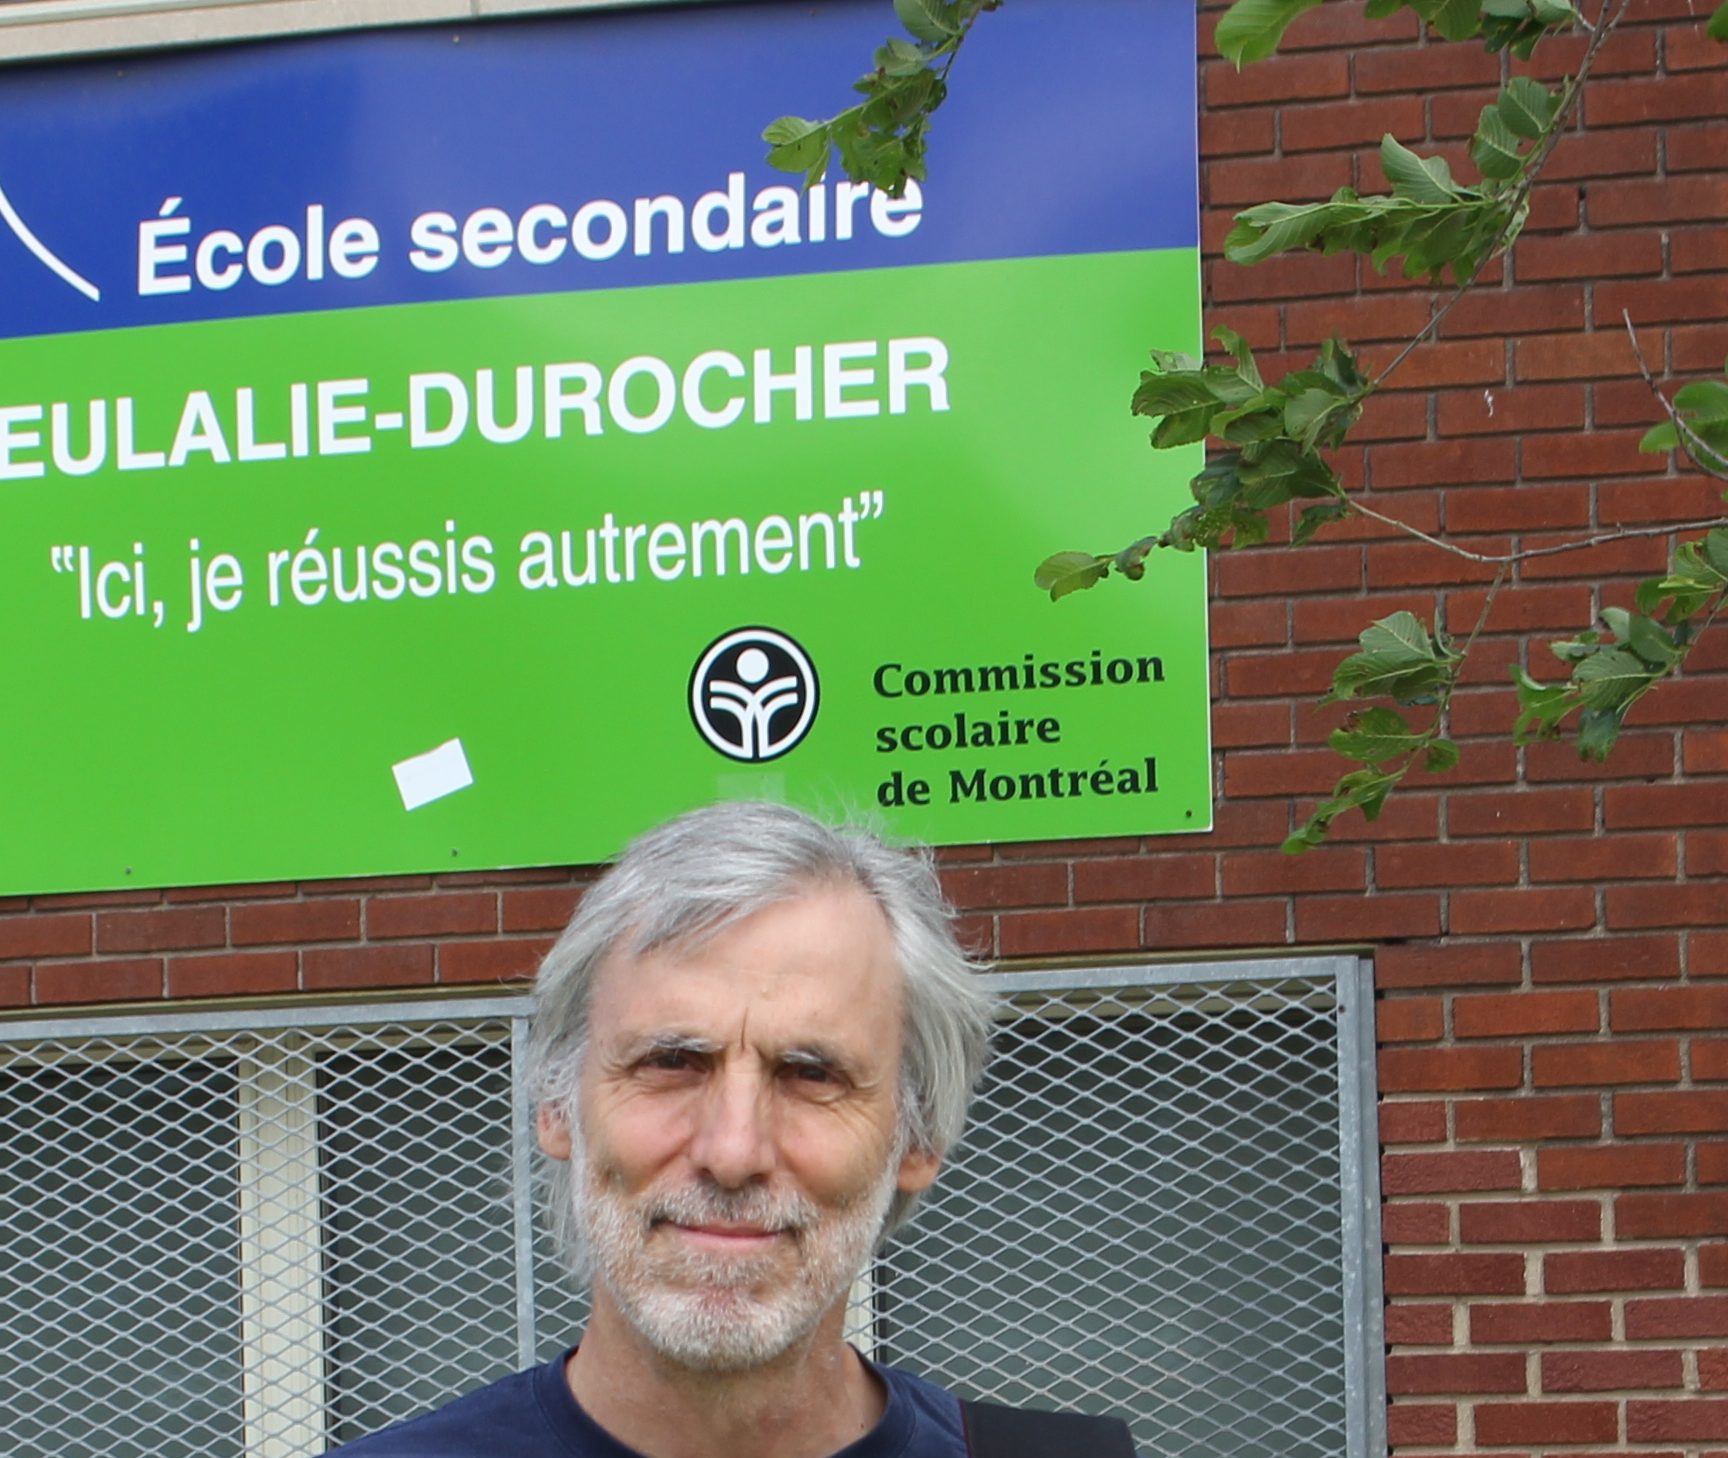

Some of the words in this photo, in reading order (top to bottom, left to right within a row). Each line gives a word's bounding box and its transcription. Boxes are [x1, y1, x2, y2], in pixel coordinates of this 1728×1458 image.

[137, 196, 380, 296] École
[408, 170, 924, 273] secondaire
[186, 537, 244, 634] je
[267, 519, 496, 607] réussis
[872, 649, 1166, 699] Commission
[875, 709, 1061, 754] scolaire
[876, 770, 931, 808] de
[948, 756, 1159, 803] Montréal
